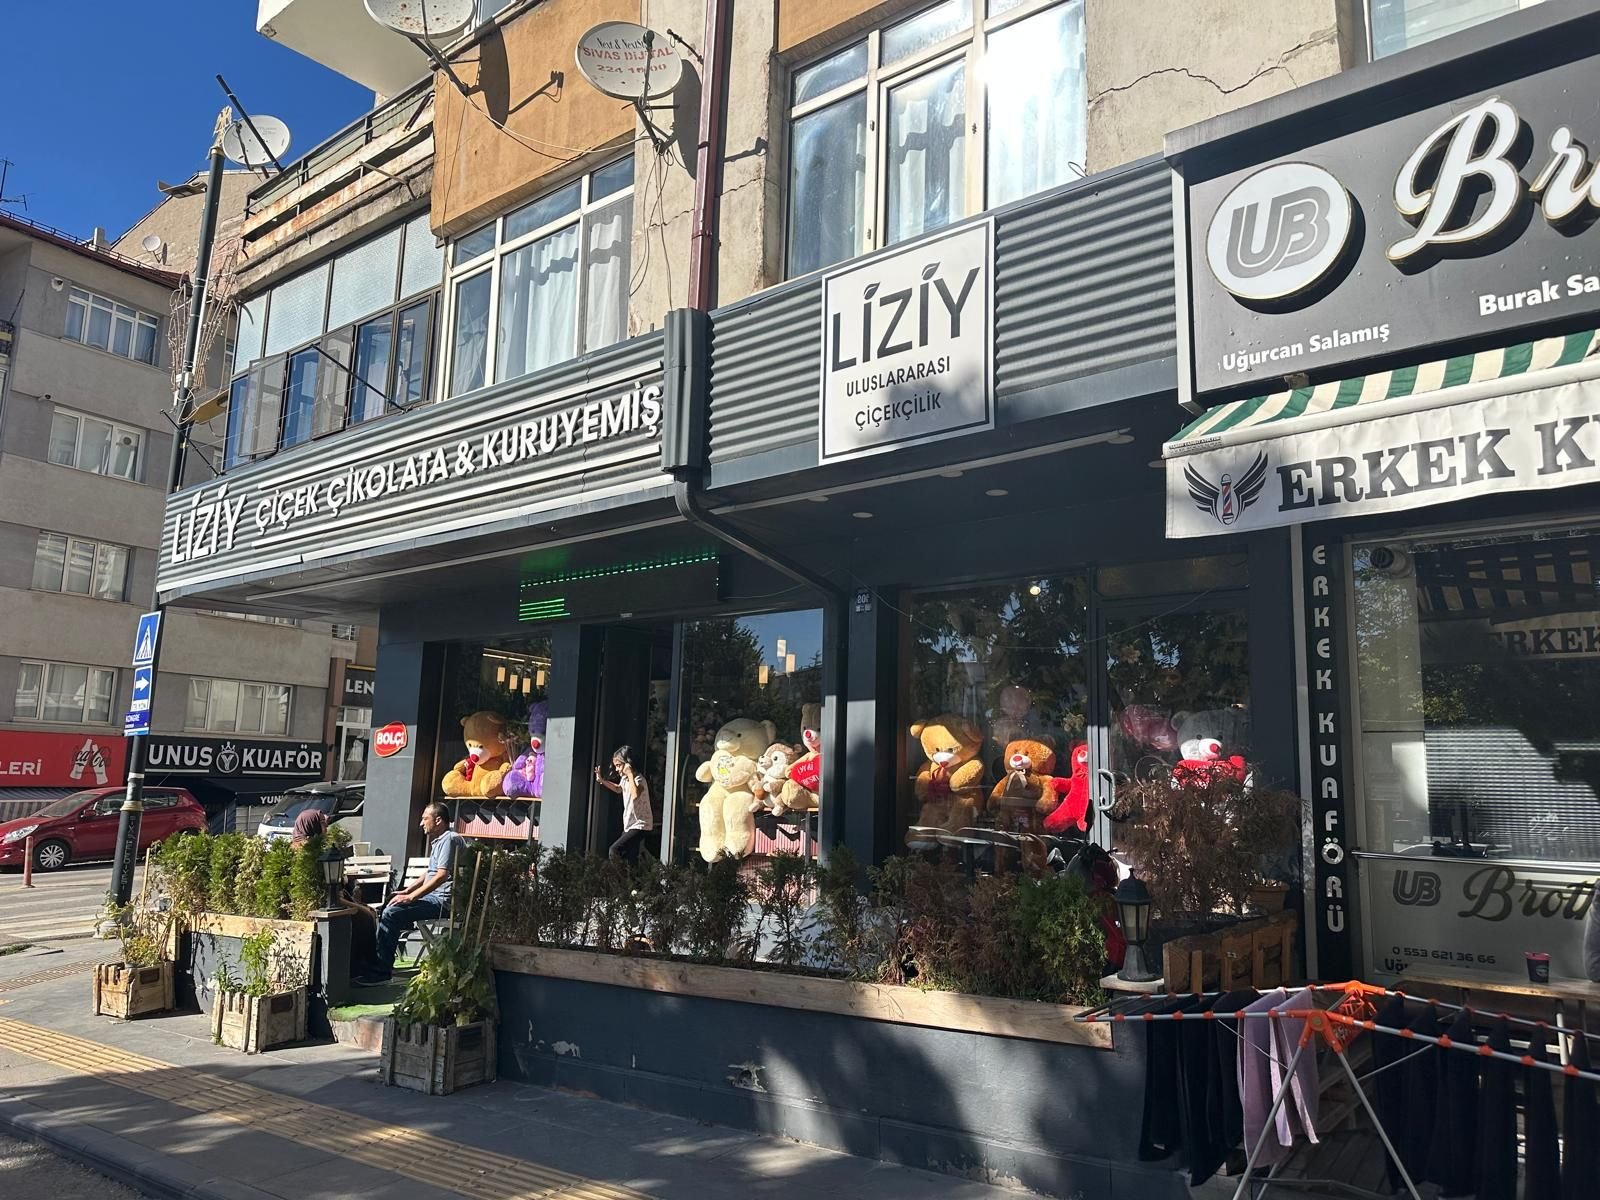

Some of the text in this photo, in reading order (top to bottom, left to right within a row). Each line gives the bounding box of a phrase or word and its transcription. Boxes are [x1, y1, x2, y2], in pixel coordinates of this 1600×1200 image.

[1385, 95, 1600, 260] Br
[1226, 186, 1331, 279] UB
[832, 262, 980, 372] LİZİY
[1478, 280, 1560, 316] Burak
[1222, 323, 1390, 373] Uğurcan Salamış
[846, 355, 951, 397] ULUSLARARASI
[855, 391, 941, 431] ÇİÇEKÇİLİK
[172, 381, 663, 564] LİZİY ÇİÇEK ÇİKOLATA & KURUYEMİŞ
[1276, 414, 1600, 512] ERKEK K
[345, 678, 375, 695] LEN
[149, 744, 213, 767] UNUS
[242, 744, 322, 769] KUAFÖR
[1312, 544, 1344, 932] ERKEK KUAFÖRÜ
[260, 795, 284, 804] YUN
[1403, 947, 1428, 958] 553
[1431, 950, 1453, 960] 621
[1456, 952, 1474, 962] 36
[1477, 954, 1497, 965] 66
